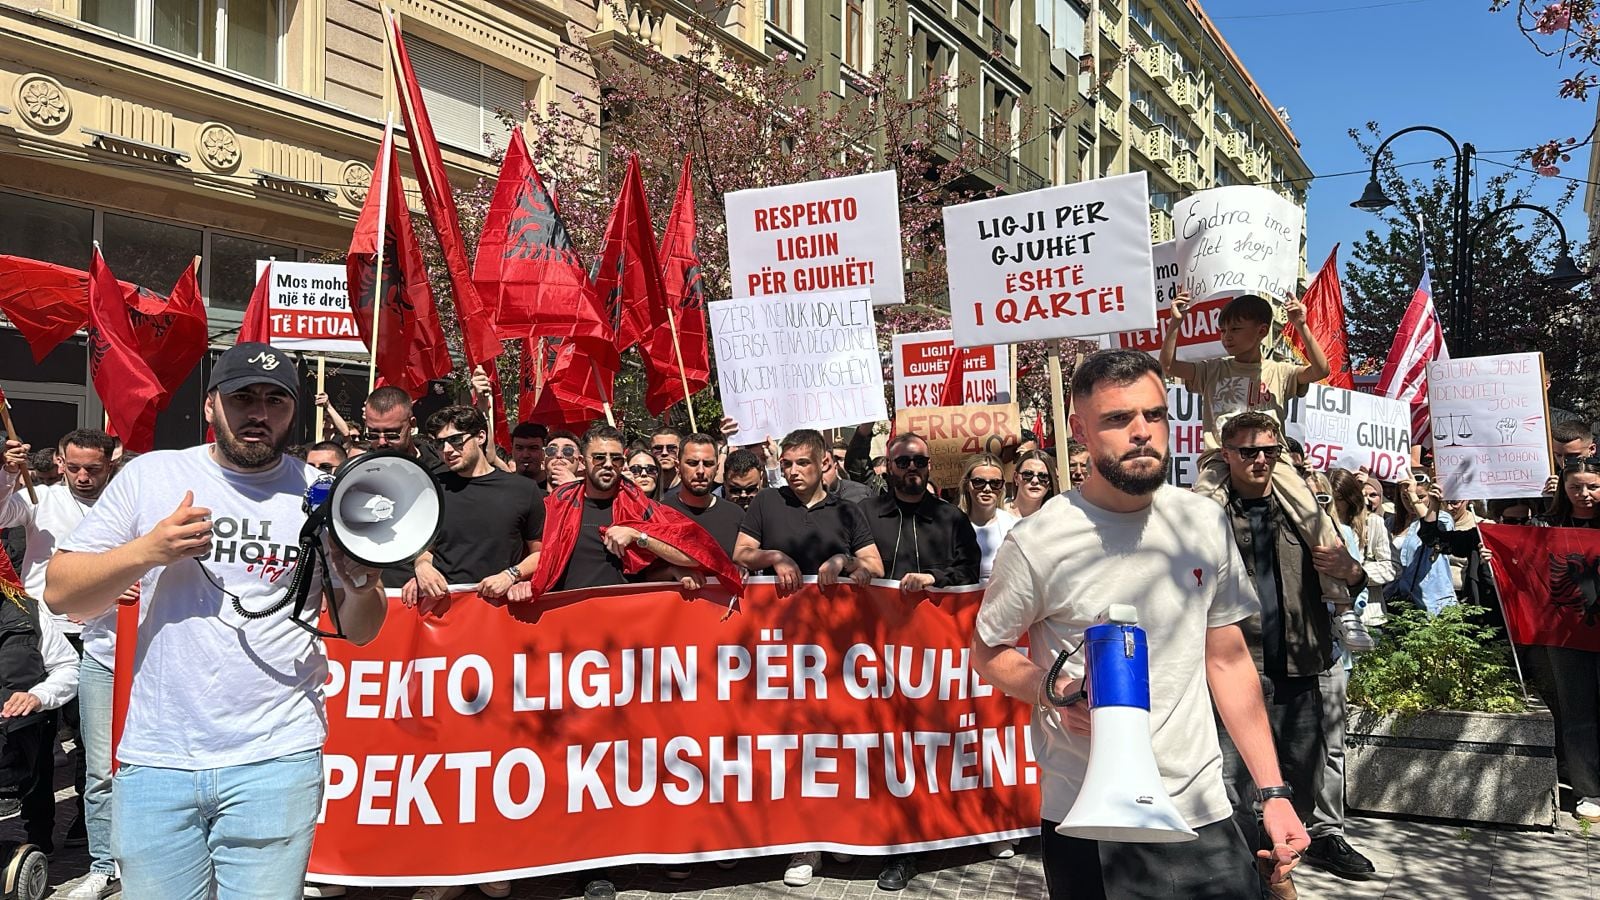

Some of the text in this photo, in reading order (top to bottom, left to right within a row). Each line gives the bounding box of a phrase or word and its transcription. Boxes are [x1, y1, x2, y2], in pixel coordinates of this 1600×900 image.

[754, 197, 857, 232] RESPEKTO
[977, 201, 1110, 240] LIGJI PËR
[1183, 200, 1292, 241] Endrra ime
[777, 232, 839, 262] LIGJIN
[991, 232, 1096, 265] GJUHËT
[1190, 236, 1222, 272] flet
[277, 274, 307, 288] Mos
[748, 258, 875, 296] PËR GJUHËT!
[1006, 264, 1085, 294] ËSHTË
[1214, 271, 1246, 288] ma
[279, 292, 349, 309] një të drej
[785, 302, 808, 328] NUK
[812, 299, 871, 327] NDALET
[974, 286, 1126, 326] I QARTË!
[270, 314, 292, 333] TË
[719, 333, 771, 361] DERISA
[787, 331, 803, 354] NA
[921, 345, 946, 358] LIGJI
[909, 358, 949, 373] GJUHËT
[1430, 362, 1478, 381] GJUHA
[723, 368, 752, 394] NUK
[904, 383, 928, 407] LEX
[908, 411, 1012, 440] ERROR
[1371, 398, 1408, 427] NA
[1357, 422, 1411, 454] GJUHA
[1439, 451, 1539, 467] MOS NA MOHONI
[513, 645, 698, 712] LIGJIN
[717, 628, 828, 701] PËR
[317, 712, 1037, 826] PEKTO KUSHTETUTËN!
